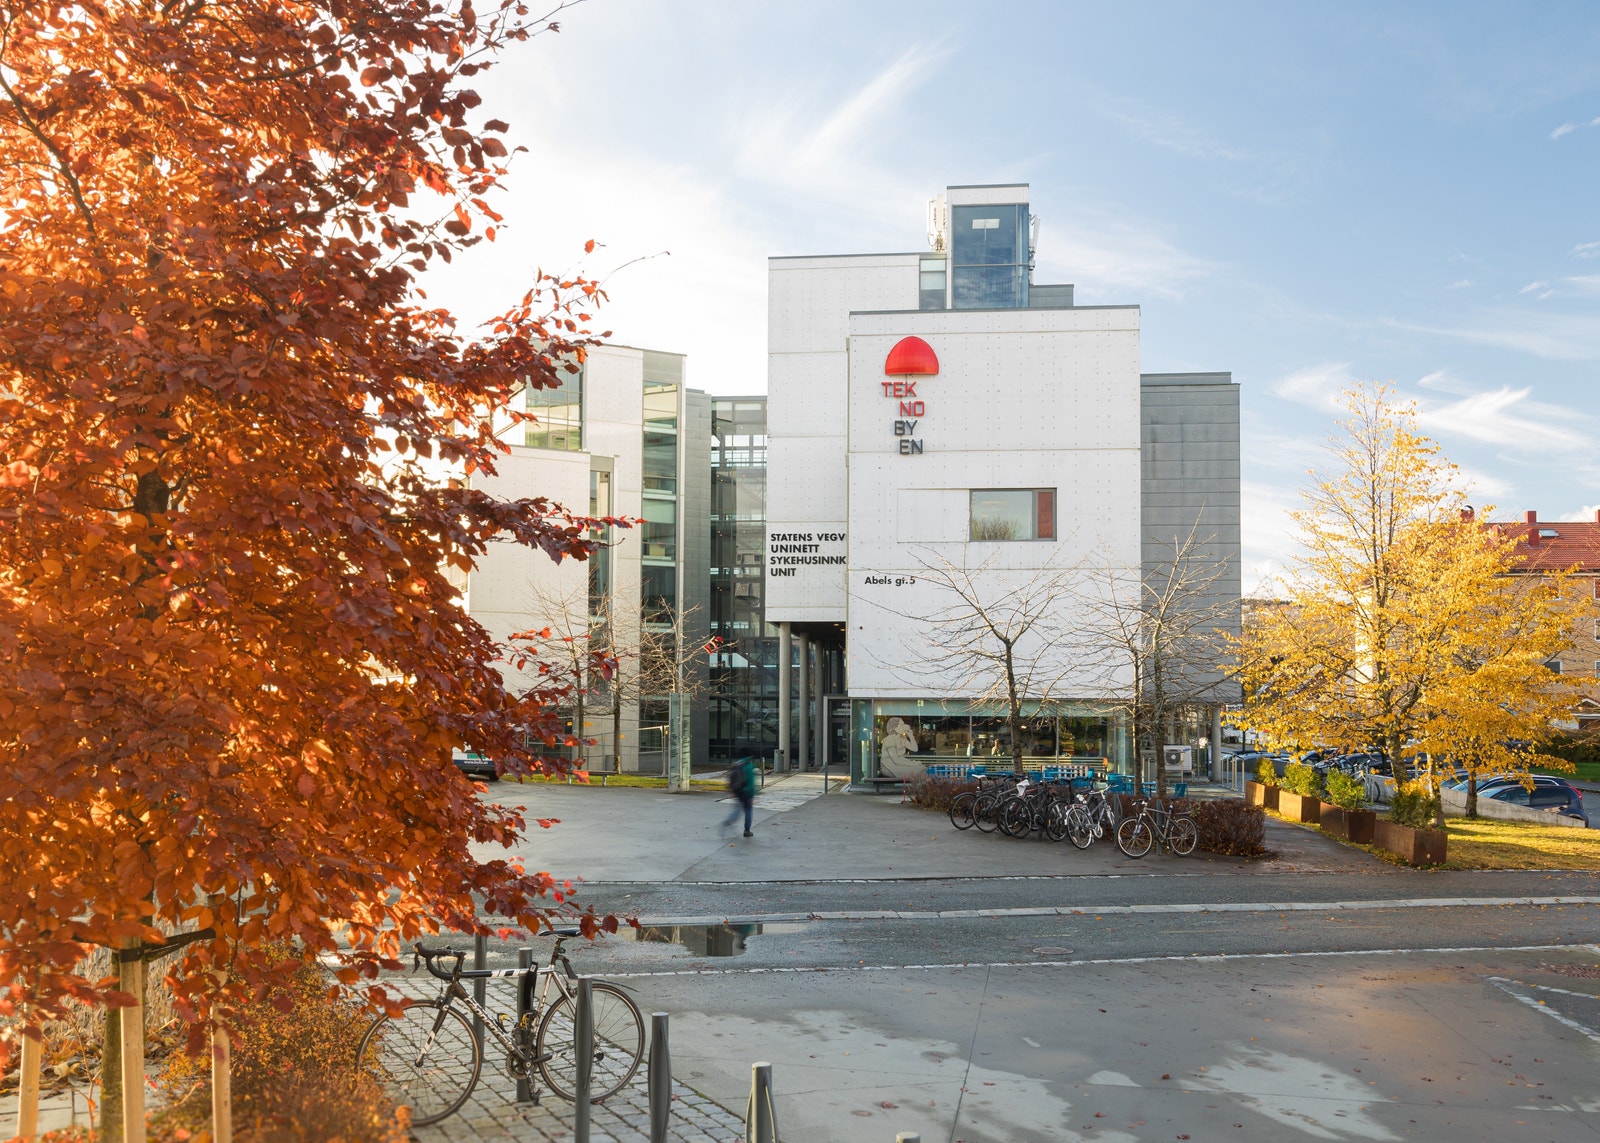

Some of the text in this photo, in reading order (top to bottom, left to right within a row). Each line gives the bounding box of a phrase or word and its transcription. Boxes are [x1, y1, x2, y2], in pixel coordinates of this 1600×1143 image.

[881, 381, 917, 398] TEK
[899, 401, 925, 417] NO
[894, 420, 918, 436] BY
[899, 439, 923, 455] EN
[770, 533, 846, 542] STATENS VEGV
[770, 544, 820, 553] UNINETT
[770, 556, 847, 565] SYKEHUSINNK
[770, 568, 797, 577] UNIT
[864, 576, 892, 585] Abels
